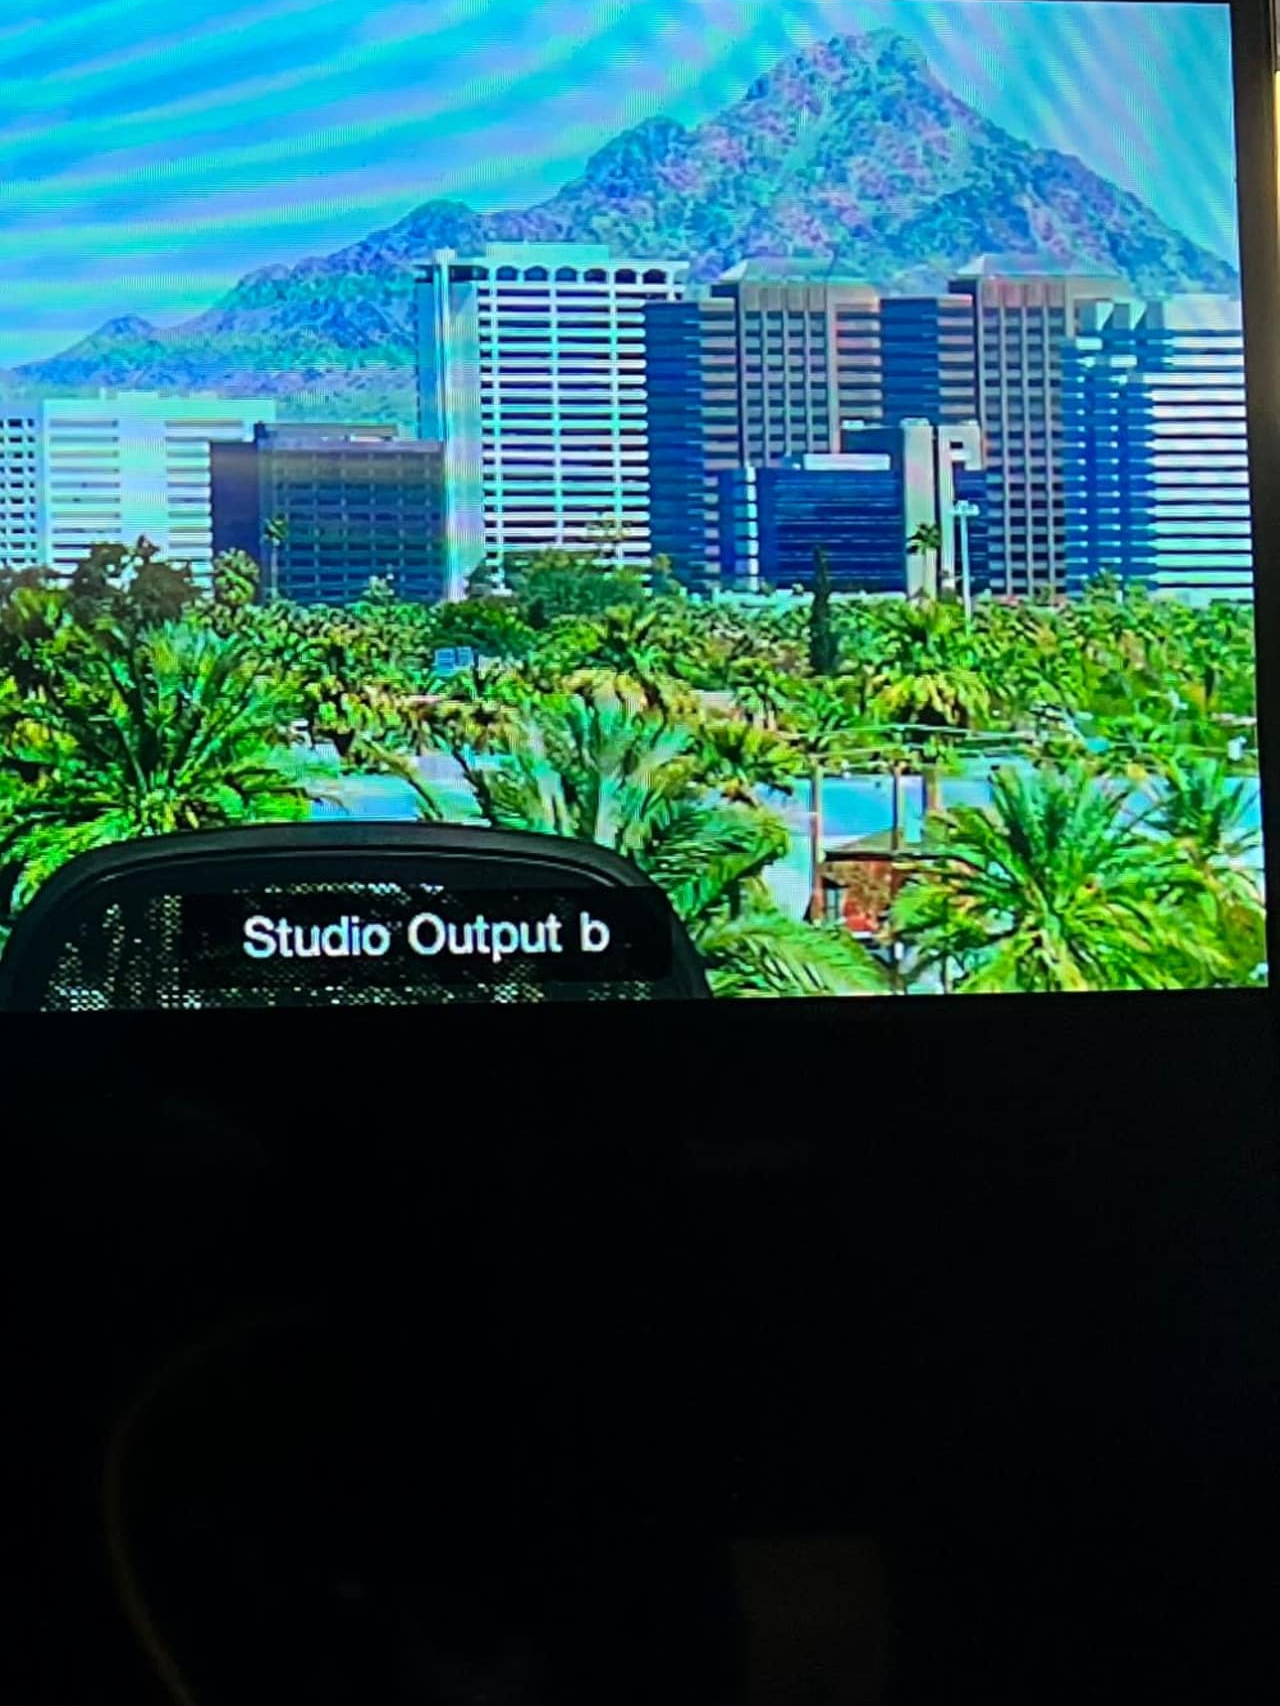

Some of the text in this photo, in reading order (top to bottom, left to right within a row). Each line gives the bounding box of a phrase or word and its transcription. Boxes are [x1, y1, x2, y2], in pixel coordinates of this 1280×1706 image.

[242, 911, 611, 963] Studio Output b
